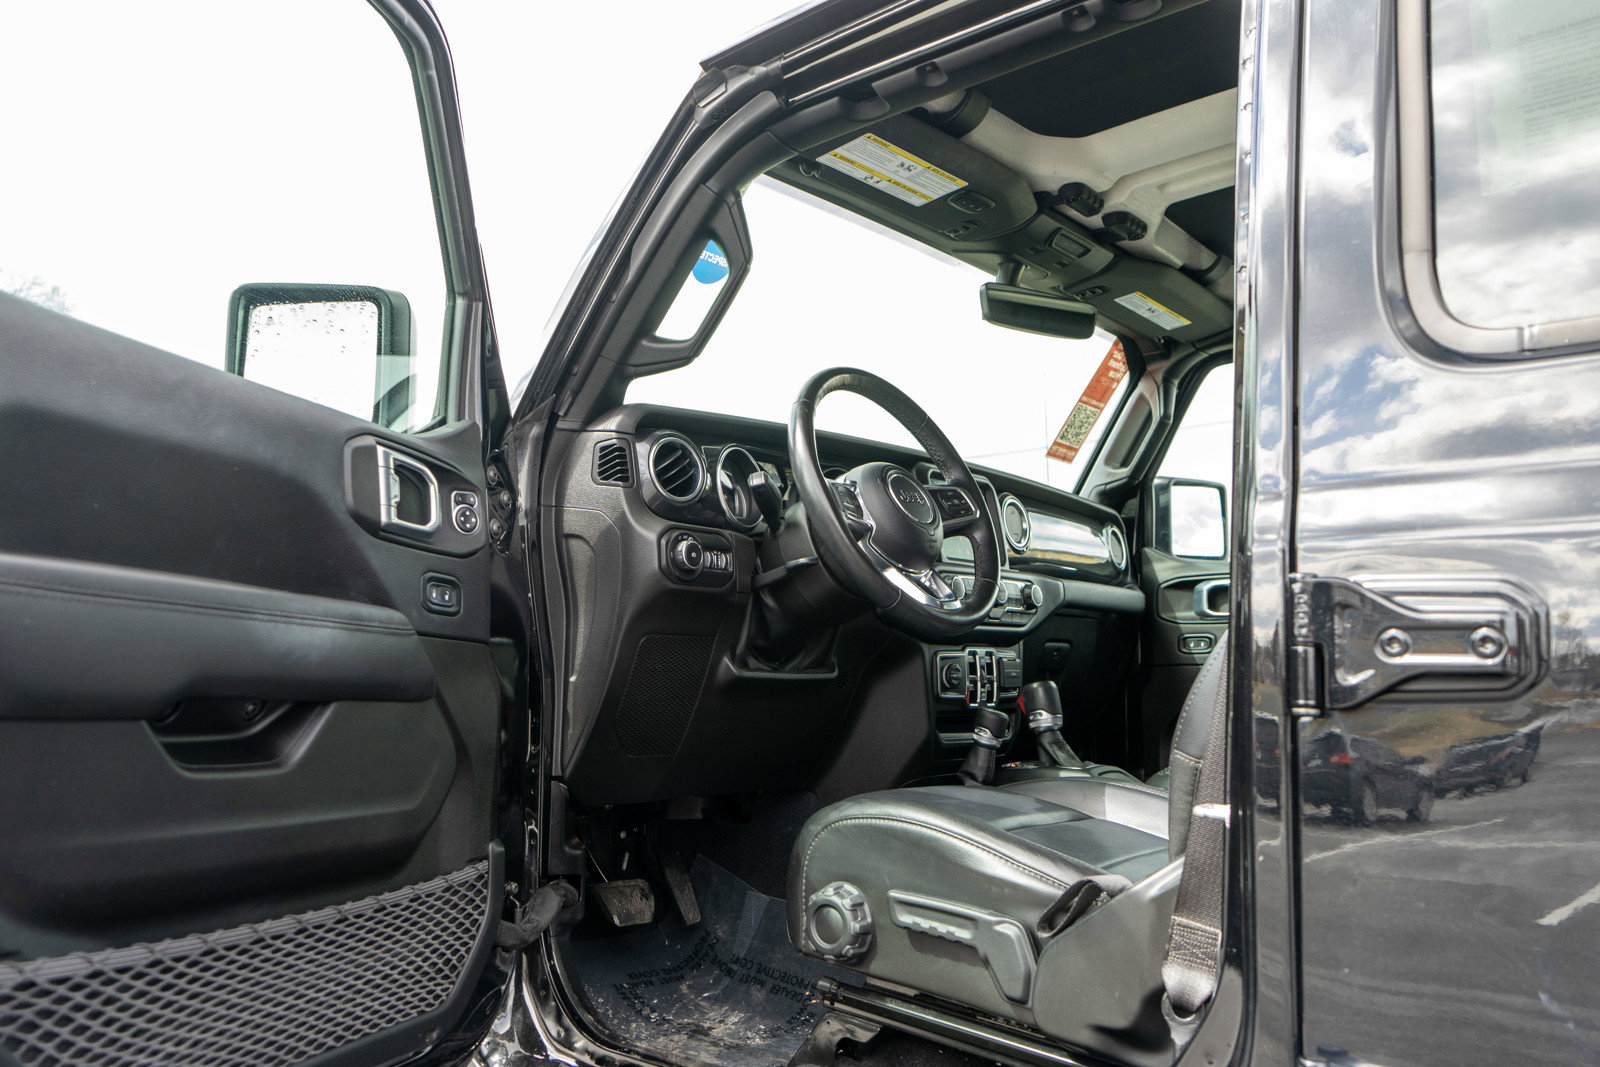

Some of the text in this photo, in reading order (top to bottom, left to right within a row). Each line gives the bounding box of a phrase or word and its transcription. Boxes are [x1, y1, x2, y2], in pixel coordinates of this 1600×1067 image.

[900, 489, 925, 504] Jeep
[626, 968, 660, 981] COVER
[658, 973, 685, 987] MUST
[739, 972, 767, 989] MUST
[756, 964, 810, 990] PROTECTIVE
[769, 983, 807, 1003] DEALER
